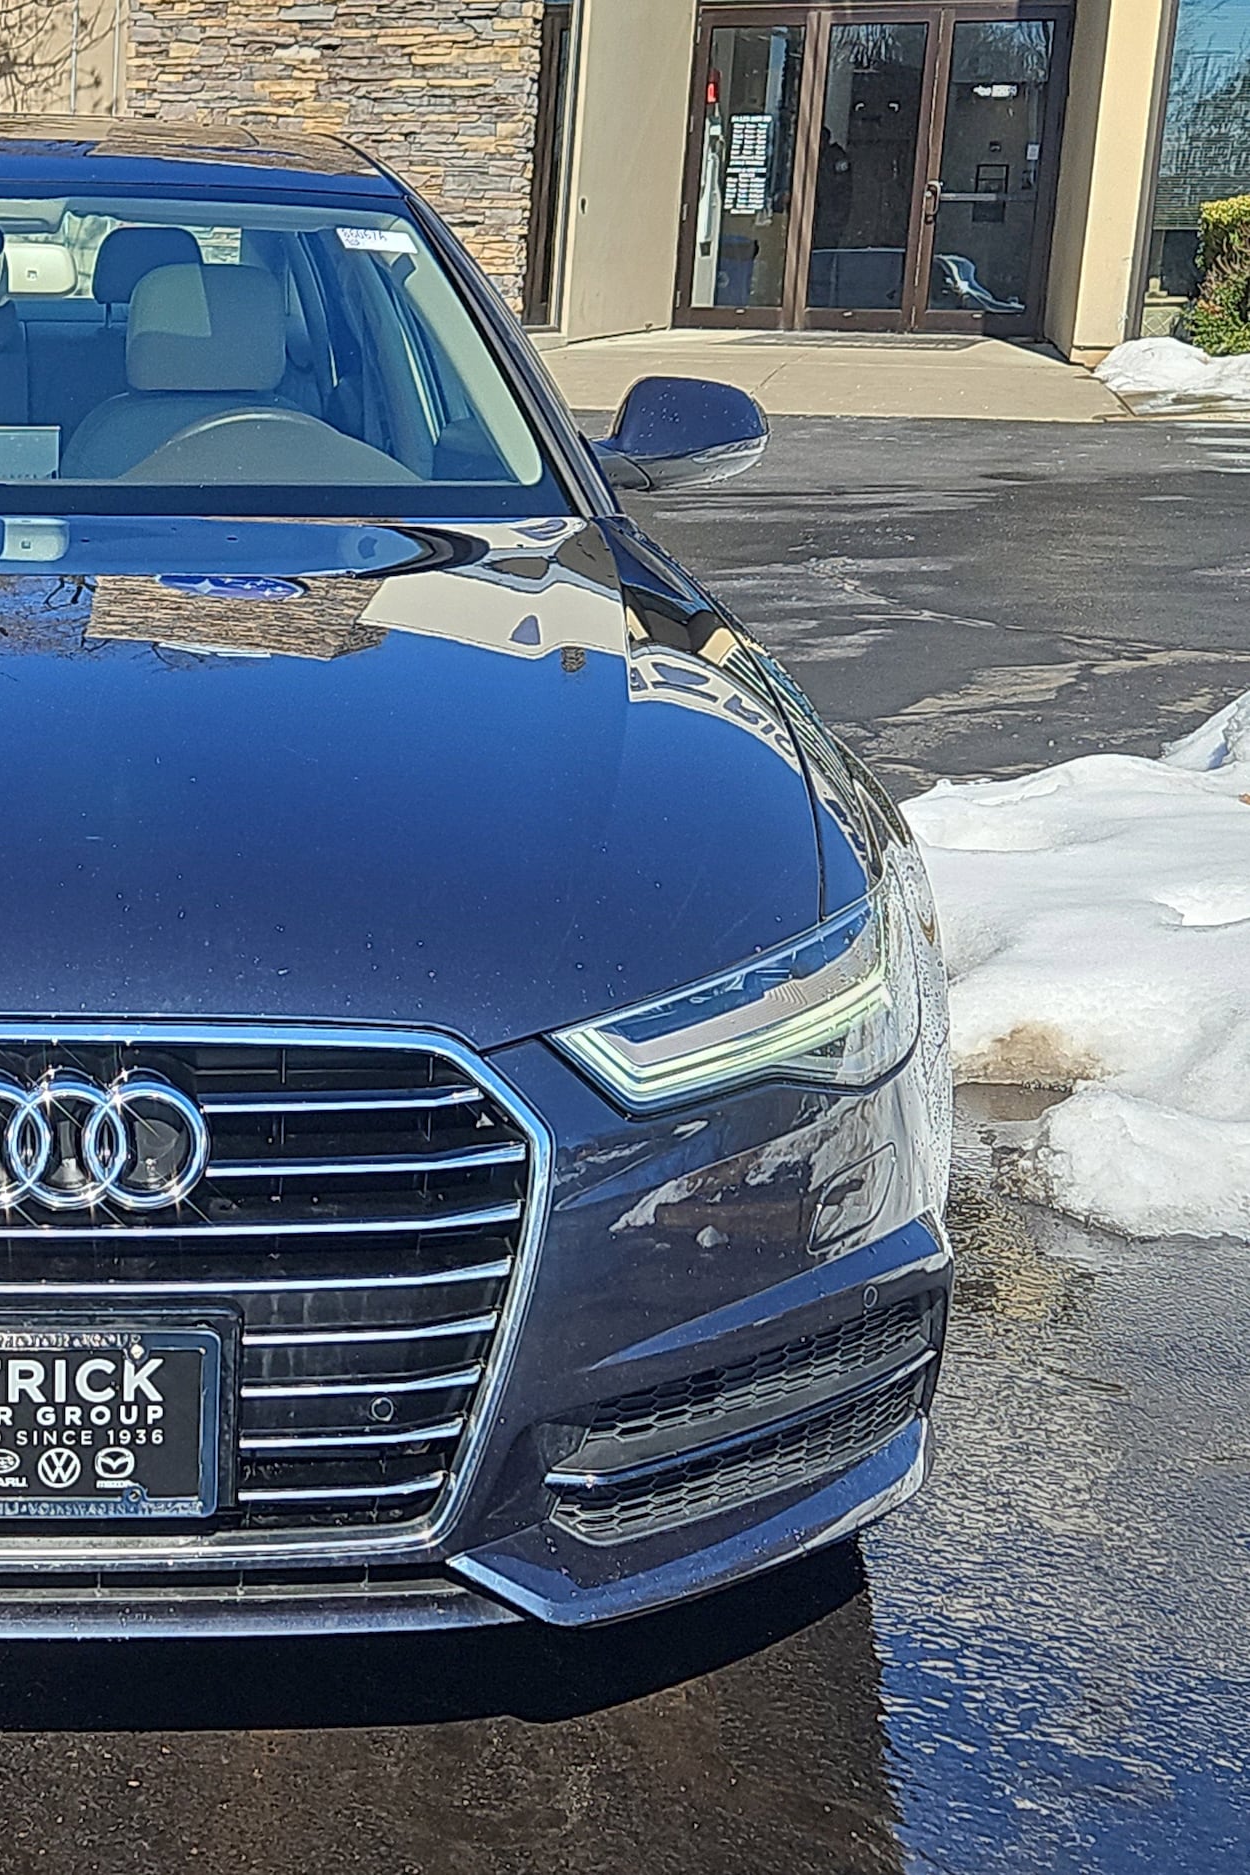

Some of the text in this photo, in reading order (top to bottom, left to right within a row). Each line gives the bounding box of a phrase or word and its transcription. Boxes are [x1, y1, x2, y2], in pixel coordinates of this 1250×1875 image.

[36, 1405, 164, 1426] GROUP
[16, 1429, 94, 1445] SINCE
[107, 1429, 165, 1445] 1936
